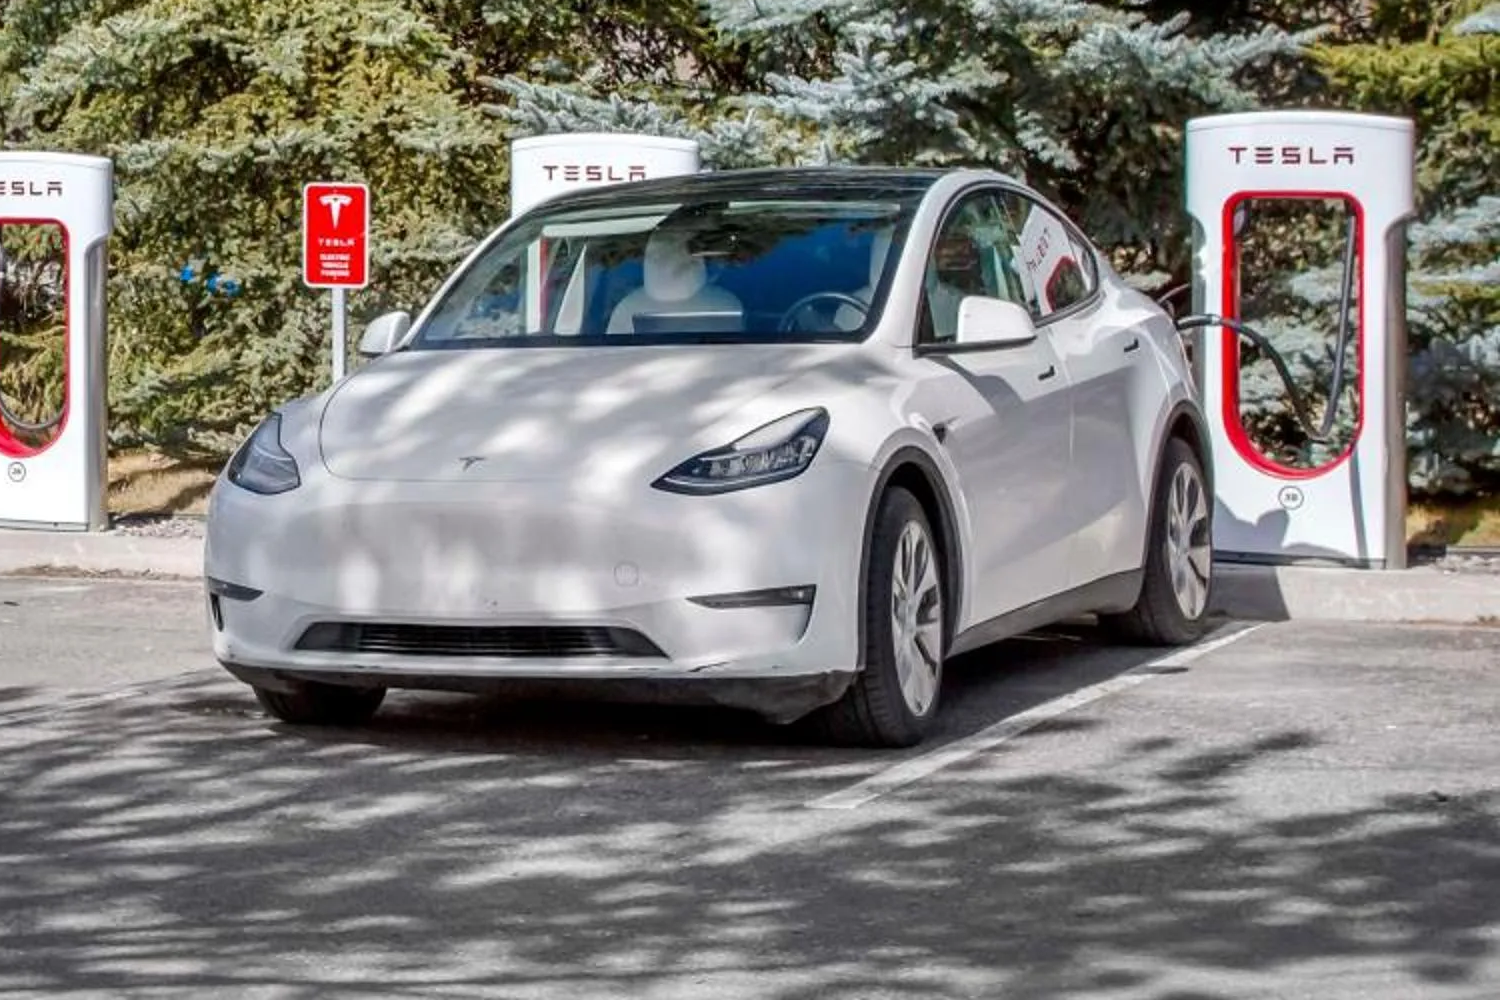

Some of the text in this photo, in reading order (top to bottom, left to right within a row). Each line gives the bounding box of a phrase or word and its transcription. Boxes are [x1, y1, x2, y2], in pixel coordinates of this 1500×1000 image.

[1228, 147, 1355, 165] TESLA
[543, 165, 646, 181] TESLA
[318, 238, 356, 248] TESLA
